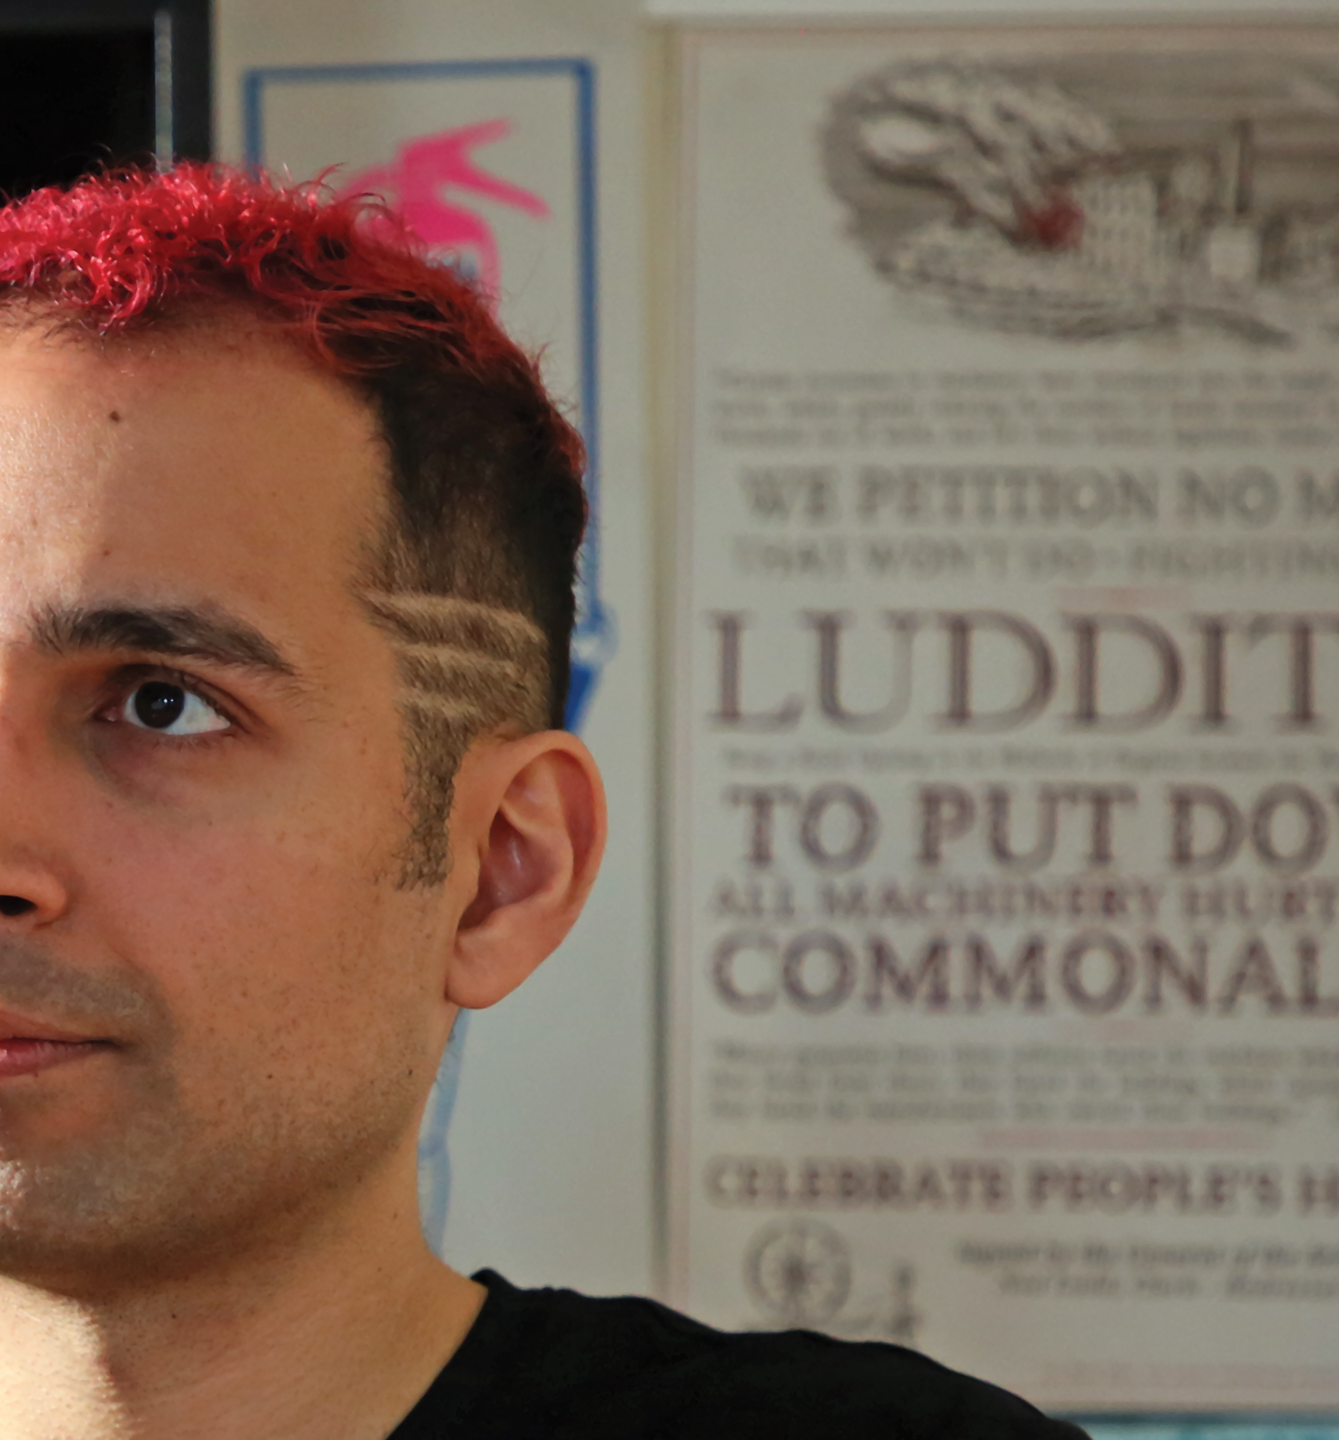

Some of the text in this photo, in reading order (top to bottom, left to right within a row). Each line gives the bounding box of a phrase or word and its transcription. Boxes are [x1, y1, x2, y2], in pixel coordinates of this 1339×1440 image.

[740, 465, 833, 523] WE
[857, 465, 1159, 525] PETITION
[1176, 465, 1281, 525] NO
[727, 781, 1339, 876] TO PUT DO
[820, 878, 1164, 922] MACHINERY
[704, 1154, 1013, 1212] CELEBRATE
[1026, 1156, 1283, 1214] PEOPLE'S
